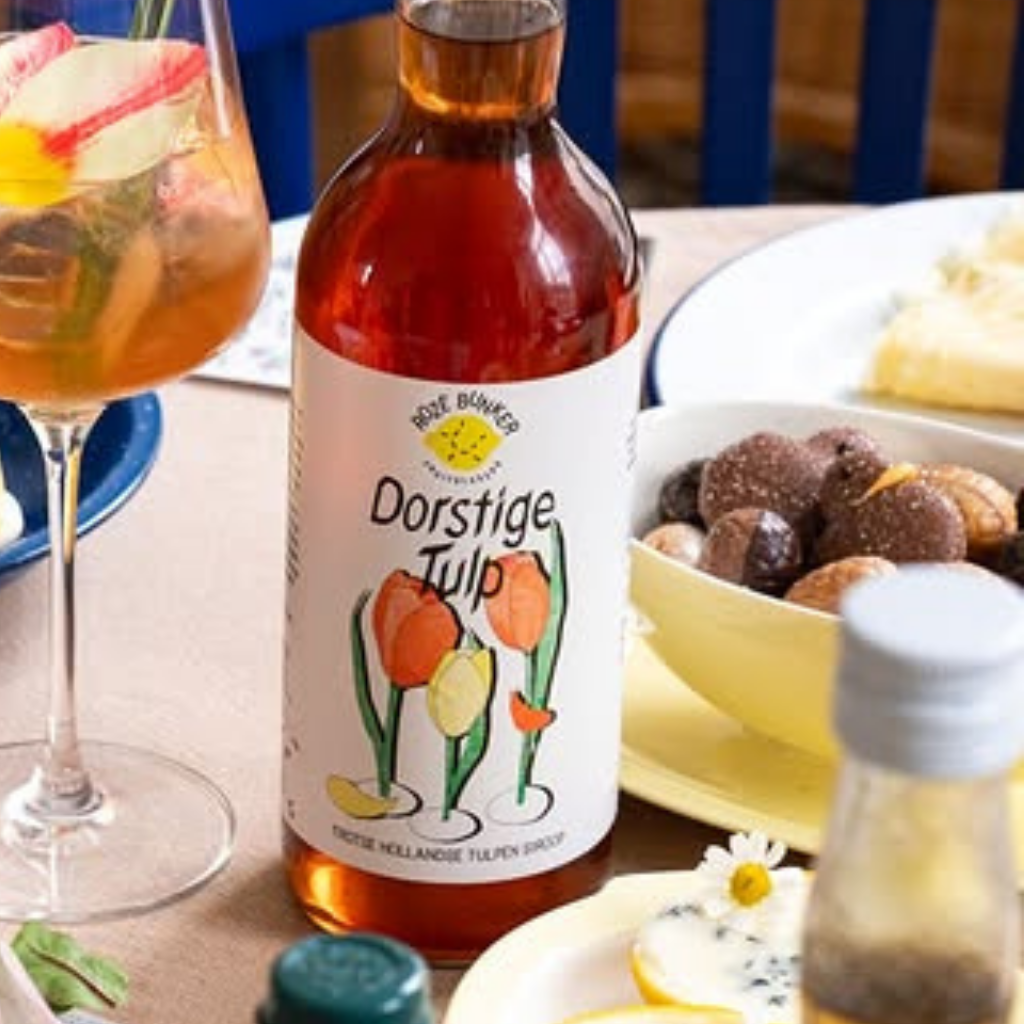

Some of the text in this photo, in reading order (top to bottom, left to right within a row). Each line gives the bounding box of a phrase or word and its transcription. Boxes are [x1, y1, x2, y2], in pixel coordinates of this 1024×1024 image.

[370, 475, 555, 548] Dorstige
[417, 541, 504, 612] Tulp
[379, 840, 461, 864] HOLLANDSE
[468, 845, 519, 862] TULPEN
